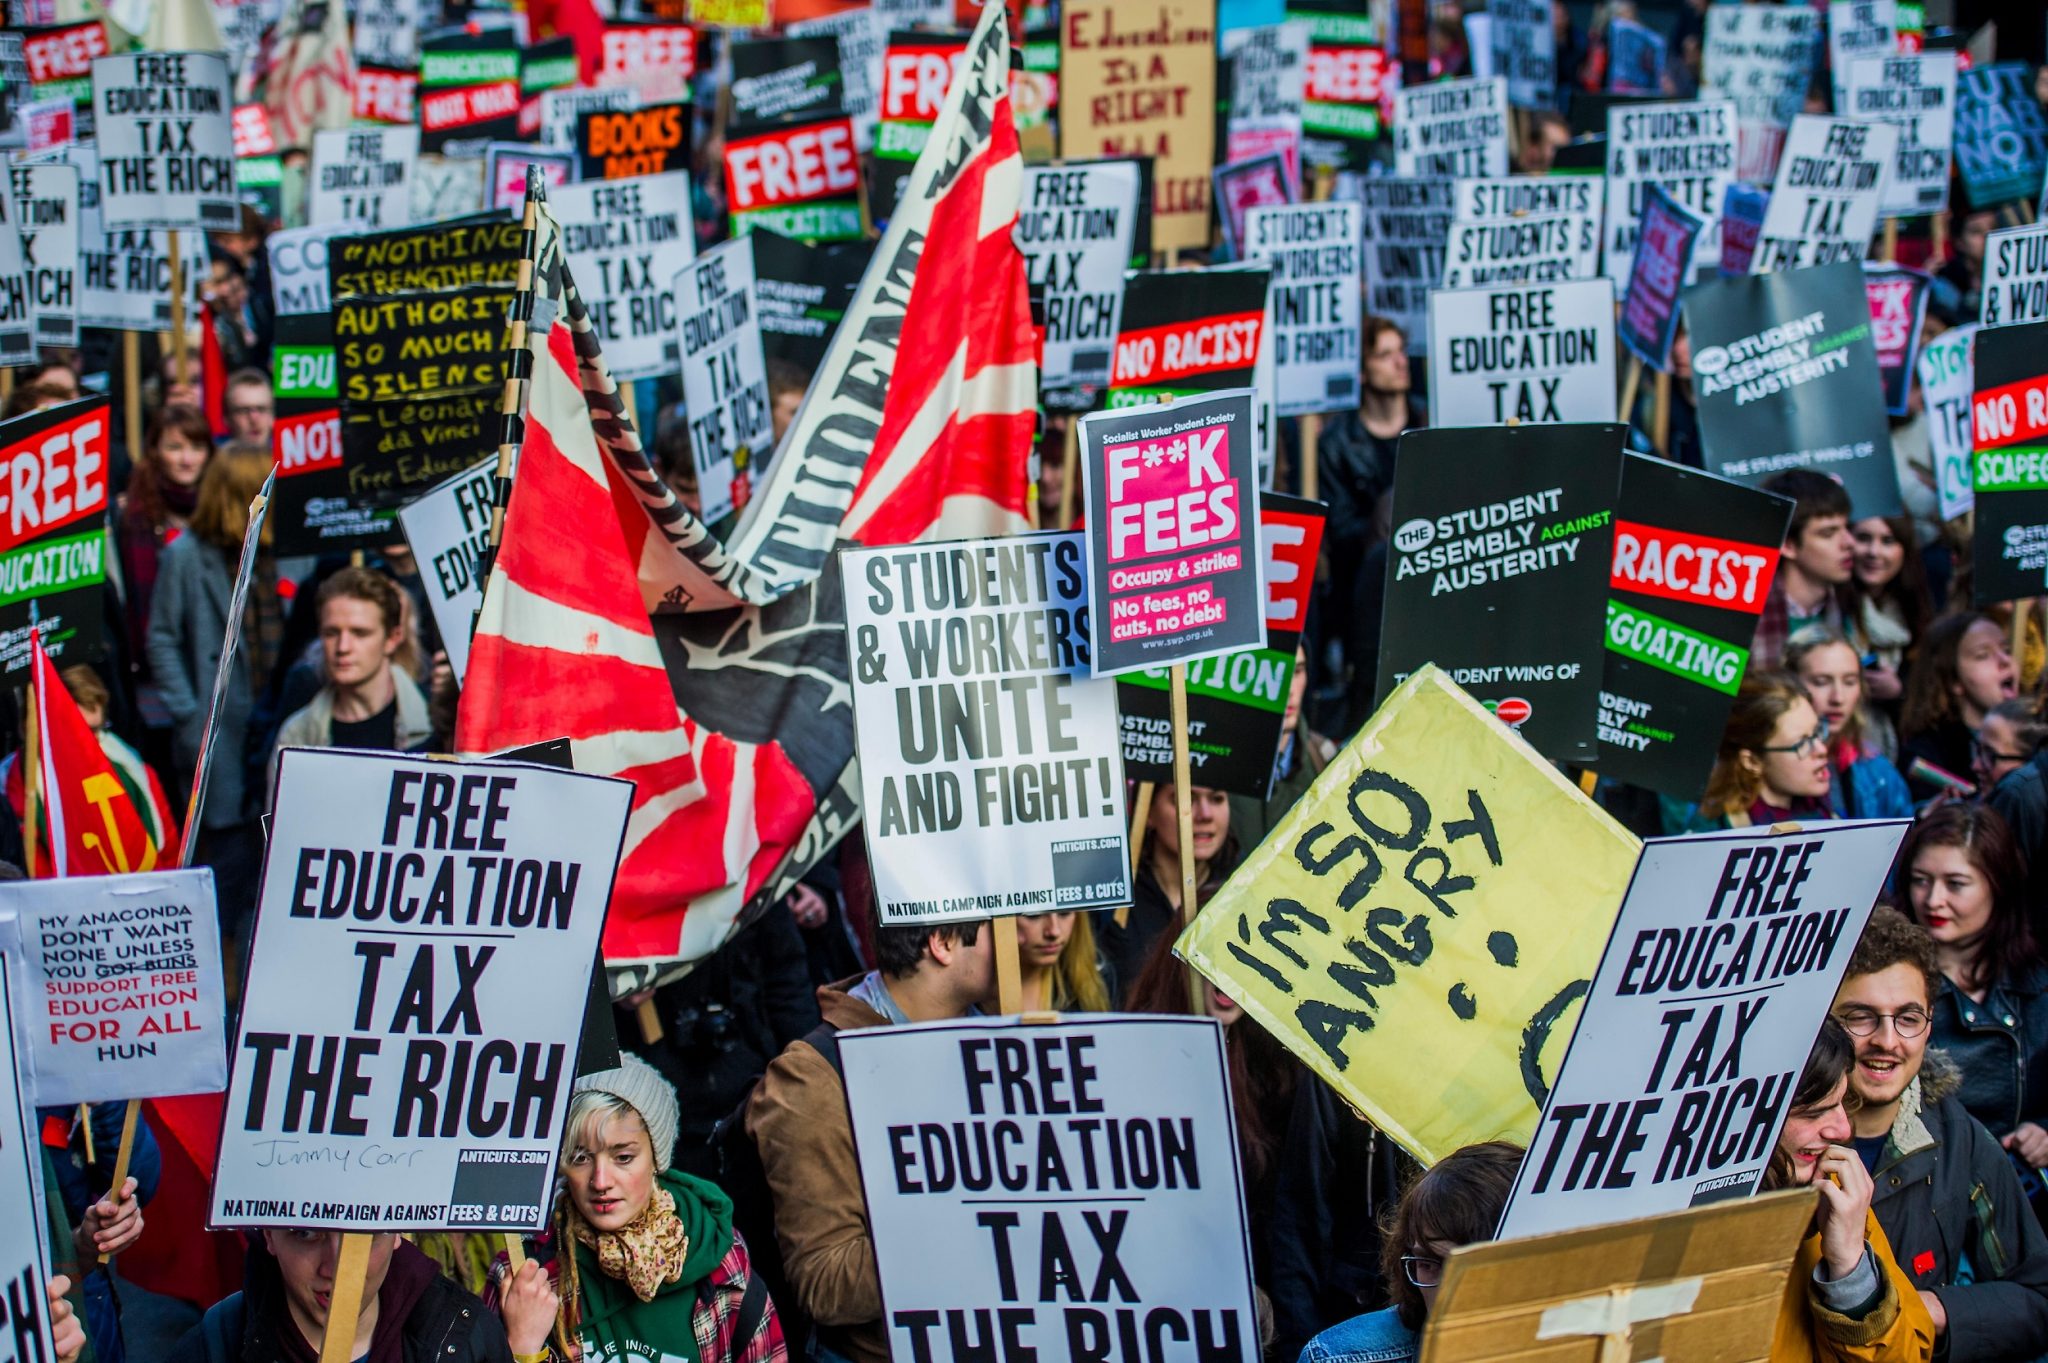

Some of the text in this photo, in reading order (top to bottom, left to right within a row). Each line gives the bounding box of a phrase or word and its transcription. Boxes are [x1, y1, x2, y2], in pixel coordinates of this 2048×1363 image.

[27, 23, 107, 80] FREE
[136, 56, 187, 84] FREE
[602, 27, 694, 78] FREE
[1149, 54, 1168, 80] A
[1883, 57, 1922, 88] FREE
[106, 88, 221, 114] EDUCATION
[1091, 87, 1189, 127] RIGHT
[1407, 84, 1494, 117] STUDENTS
[1857, 88, 1944, 112] EDUCATION
[136, 121, 194, 153] TAX
[587, 106, 683, 157] BOOKS
[1420, 114, 1499, 144] WORKERS
[1622, 109, 1725, 142] STUDENTS
[1824, 124, 1869, 158] FREE
[349, 135, 383, 160] FREE
[605, 151, 665, 179] NOT
[727, 126, 855, 205] FREE
[1613, 144, 1732, 177] & WORKERS
[101, 160, 158, 193] THE
[167, 160, 233, 194] RICH
[322, 163, 403, 190] EDUCATION
[1034, 171, 1089, 207] FREE
[1789, 156, 1880, 190] EDUCATION
[593, 184, 643, 218] FREE
[1473, 183, 1590, 217] STUDENTS
[1802, 199, 1853, 235] TAX
[563, 212, 678, 254] EDUCATION
[1259, 209, 1349, 244] STUDENTS
[1460, 219, 1569, 261] STUDENTS
[597, 255, 654, 294] TAX
[696, 256, 727, 305] FREE
[1026, 252, 1084, 292] TAX
[683, 289, 748, 357] EDUCATION
[1490, 289, 1554, 331] FREE
[1986, 286, 2000, 325] &
[344, 330, 492, 368] SO MUCH
[1117, 320, 1260, 380] NO RACIST
[1451, 328, 1596, 374] EDUCATION
[1728, 311, 1824, 363] STUDENT
[706, 344, 743, 402] TAX
[1702, 340, 1810, 396] ASSEMBLY
[1736, 347, 1849, 405] AUSTERITY
[1489, 377, 1562, 423] TAX
[1975, 394, 2018, 442] NO
[280, 419, 342, 468] NOT
[421, 423, 480, 446] Vinci
[690, 381, 766, 473] THE RICH
[1103, 412, 1236, 444] Socialist Worker Student Society
[1721, 442, 1874, 477] THE STUDENT WING OF
[1110, 484, 1237, 559] FEES
[1400, 488, 1563, 547] THE STUDENT
[1396, 510, 1612, 581] ASSEMBLY AGAINST
[866, 540, 1082, 616] STUDENTS
[1111, 552, 1238, 590] Occupy & strike
[1431, 538, 1580, 597] AUSTERITY
[1613, 533, 1767, 604] RACIST
[1113, 588, 1211, 619] No fees, no
[1113, 604, 1223, 639] cuts, no debt
[857, 606, 1091, 685] & WORKERS
[1142, 627, 1214, 649] www.swp.org.uk
[1606, 605, 1740, 684] GOATING
[1505, 663, 1581, 682] WING OF
[895, 673, 1078, 765] UNITE
[1627, 722, 1675, 742] AGAINST
[382, 769, 517, 853] FREE
[880, 757, 1114, 837] AND FIGHT!
[1052, 837, 1120, 854] ANTICUTS.COM
[1294, 768, 1431, 912] SO
[289, 846, 581, 930] EDUCATION
[888, 881, 1125, 917] NATIONAL CAMPAIGN AGAINST FEES & CUTS
[1706, 840, 1824, 920] FREE
[39, 905, 192, 930] MY ANACONDA
[41, 920, 192, 948] DON'T WANT
[1295, 789, 1503, 1072] ANGRY
[42, 939, 194, 964] NONE UNLESS
[43, 955, 197, 980] YOU GOT BUNS
[1615, 908, 1851, 997] EDUCATION
[45, 970, 197, 996] SUPPORT FREE
[48, 988, 198, 1016] EDUCATION
[354, 941, 497, 1035] TAX
[50, 1010, 202, 1045] FOR ALL
[1644, 996, 1769, 1094] TAX
[98, 1041, 157, 1062] HUN
[243, 1032, 566, 1139] THE RICH
[959, 1035, 1105, 1115] FREE
[1531, 1071, 1795, 1195] THE RICH
[459, 1150, 549, 1165] ANTICUTS.COM
[887, 1117, 1201, 1194] EDUCATION
[1694, 1170, 1757, 1196] ANTICUTS.COM
[223, 1199, 539, 1222] NATIONAL CAMPAIGN AGAINST FEES & CUTS
[976, 1209, 1141, 1303] TAX
